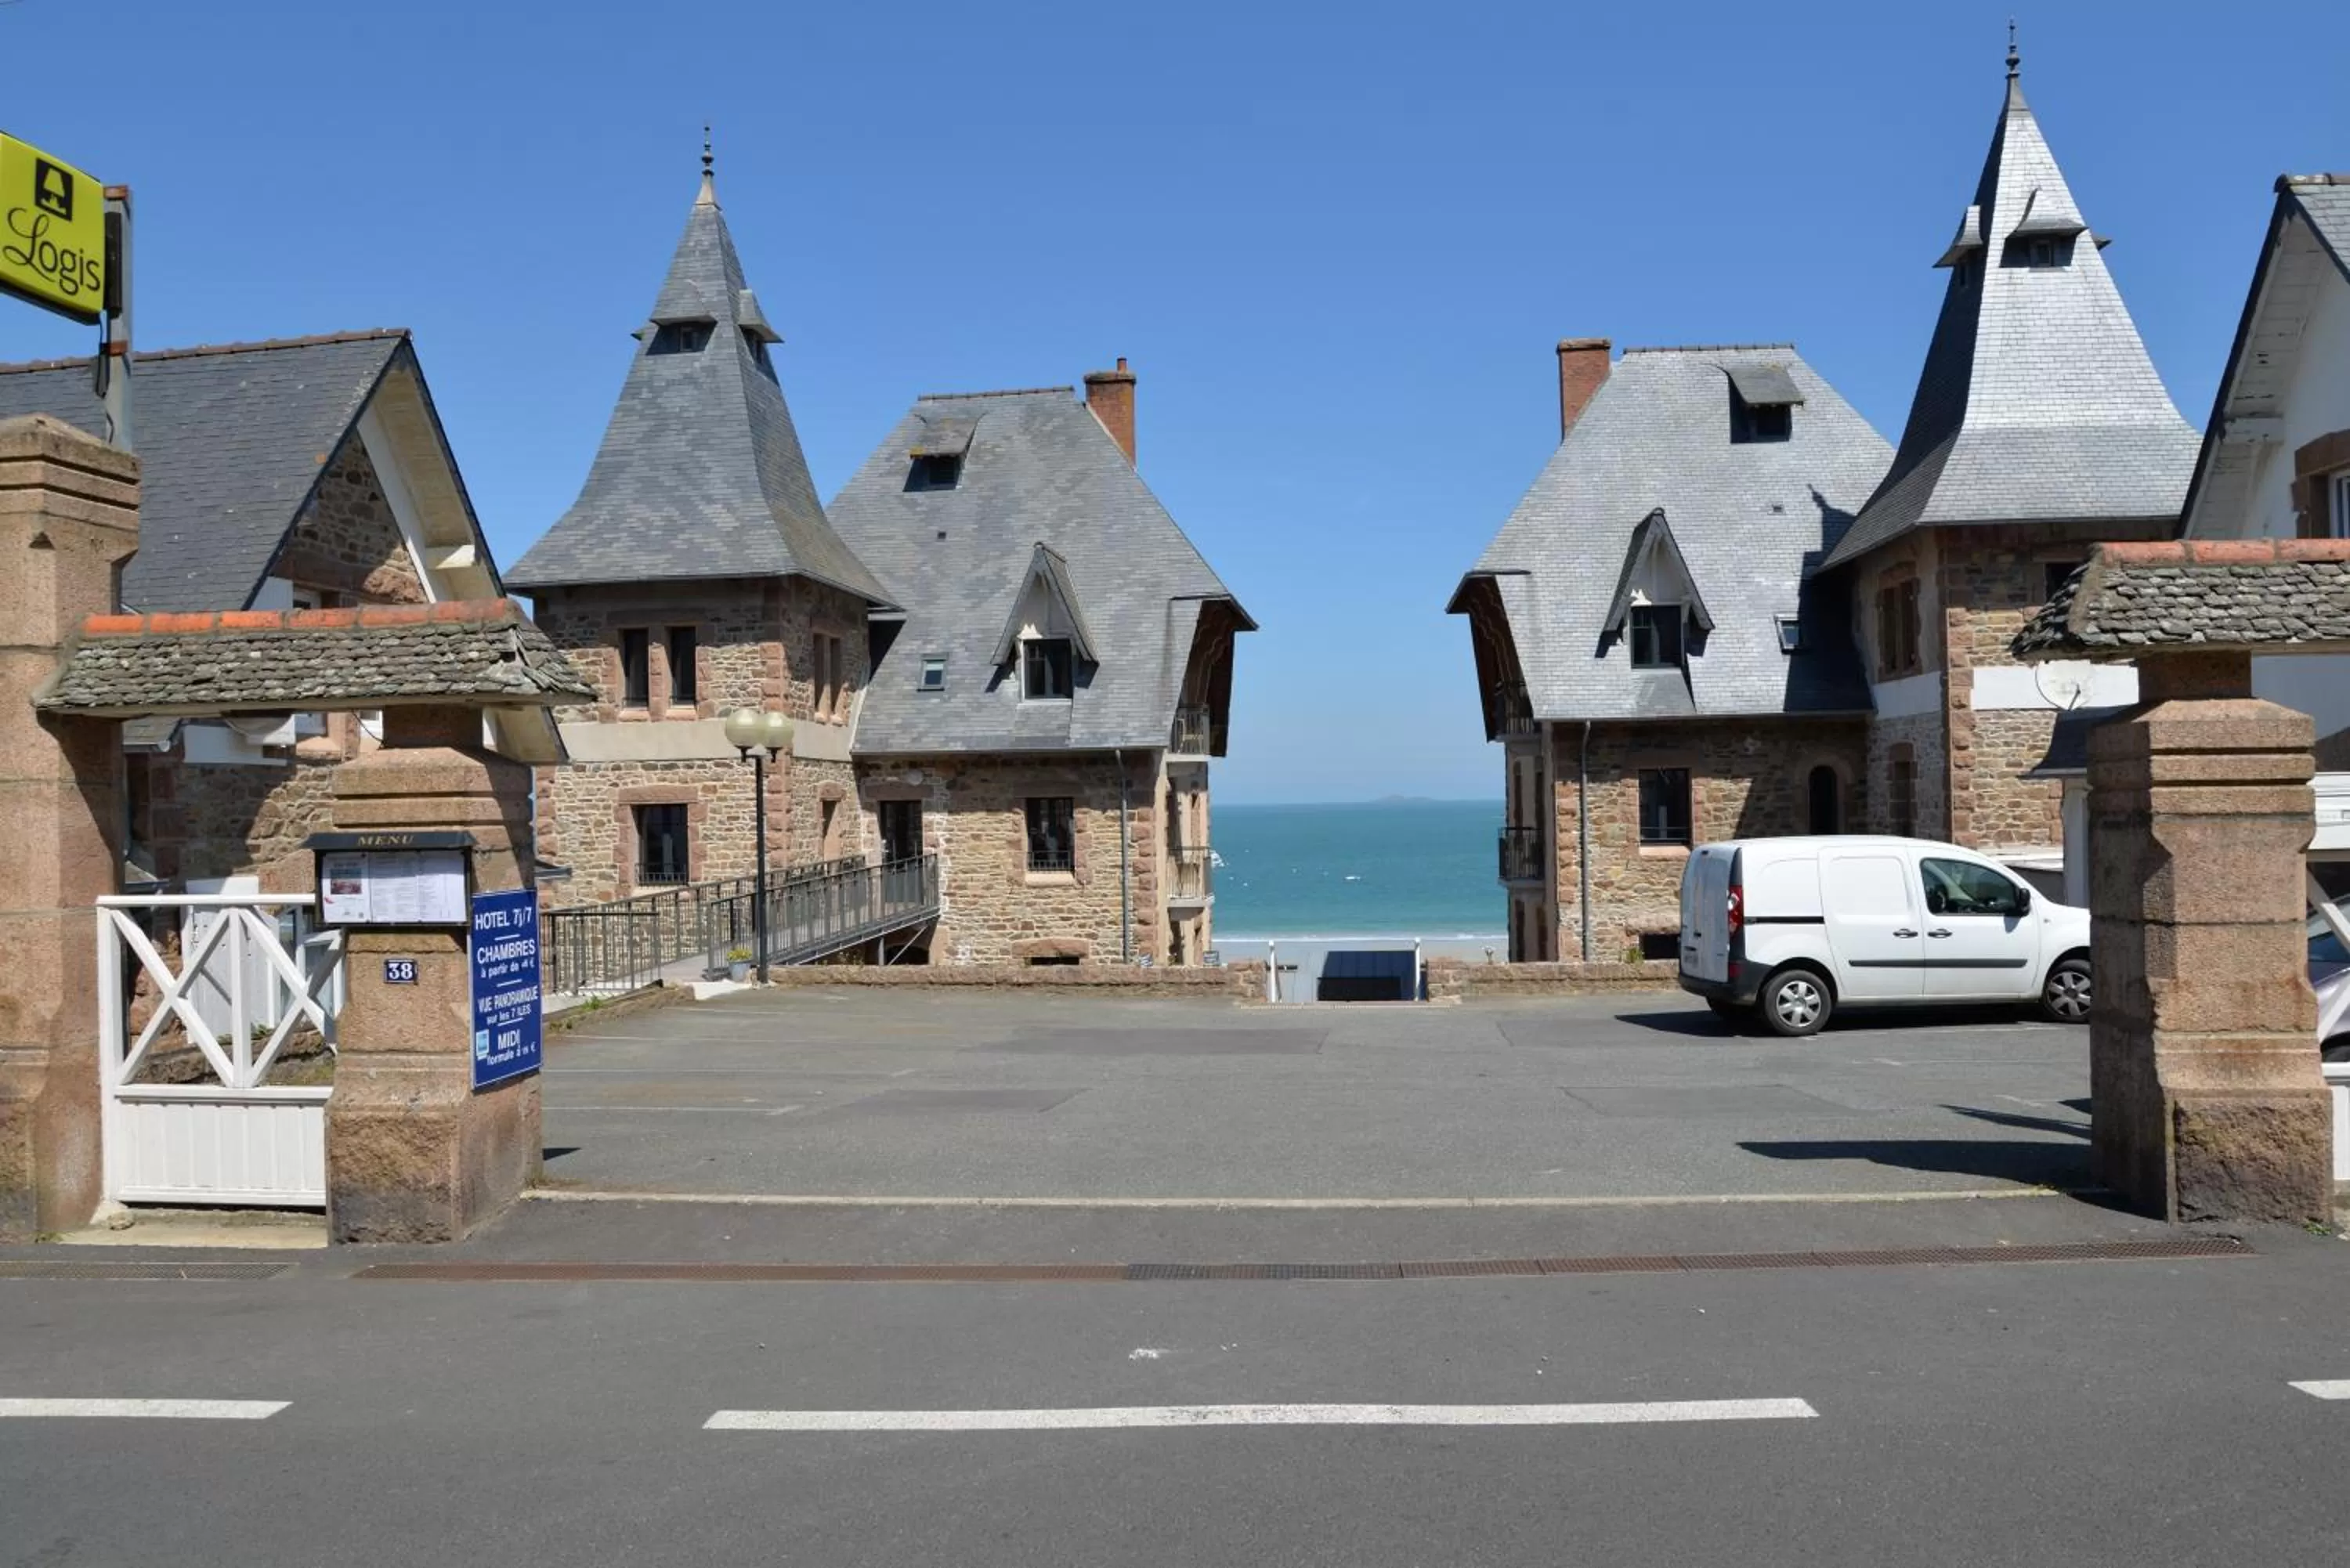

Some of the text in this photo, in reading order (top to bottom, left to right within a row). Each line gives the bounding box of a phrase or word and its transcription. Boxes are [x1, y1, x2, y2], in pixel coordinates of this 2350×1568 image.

[2, 208, 101, 296] Logis
[357, 835, 414, 847] MENU
[475, 906, 532, 930] HOTEL 7j/7
[478, 939, 535, 963] CHAMBRES
[389, 963, 413, 980] 38
[488, 962, 508, 979] partir
[478, 986, 538, 1013] VUE PANORAMIQUE
[498, 1029, 520, 1050] MIDI
